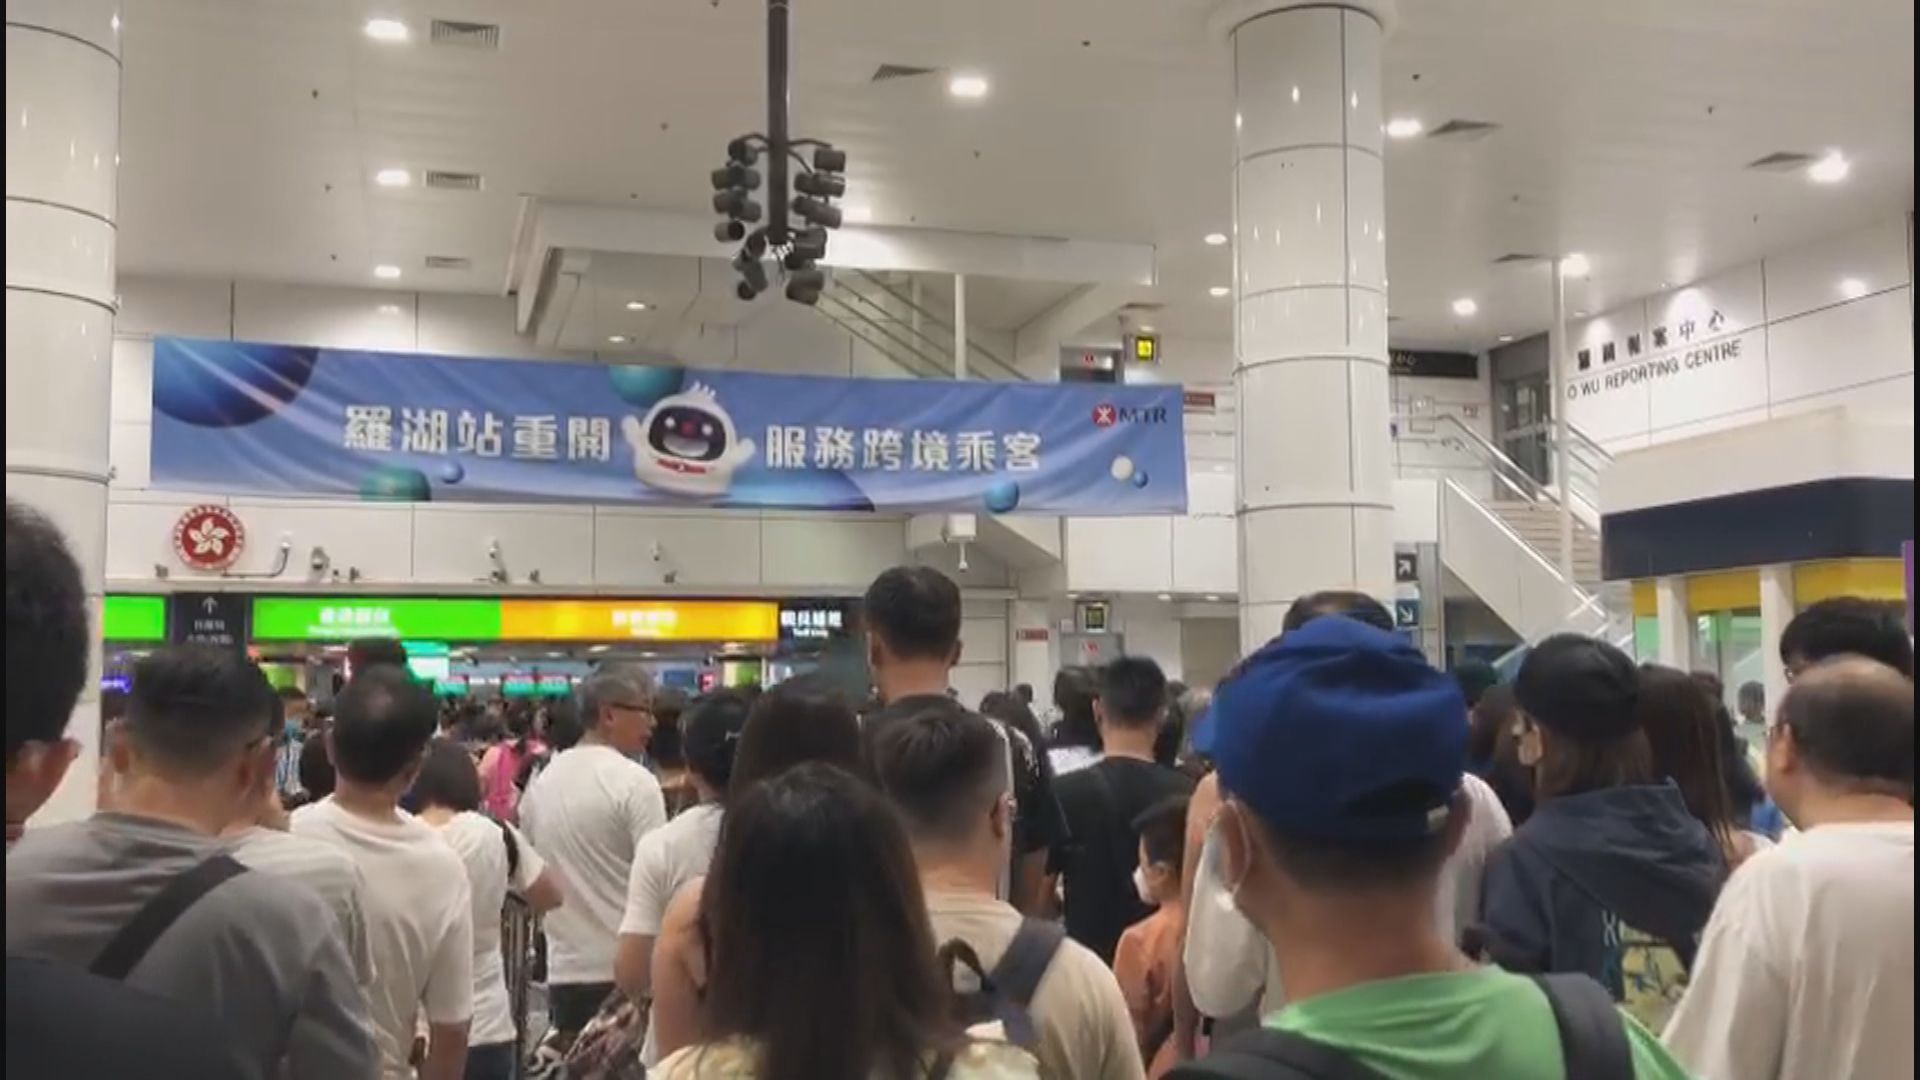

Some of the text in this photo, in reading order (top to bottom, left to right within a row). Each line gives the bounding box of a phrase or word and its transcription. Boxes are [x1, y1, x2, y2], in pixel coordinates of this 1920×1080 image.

[1581, 374, 1600, 396] WU
[1604, 356, 1680, 390] REPORTING
[1684, 338, 1743, 370] CENTRE
[344, 404, 1042, 472] 羅湖站重開 服務跨境乘客
[1118, 406, 1168, 424] MTR
